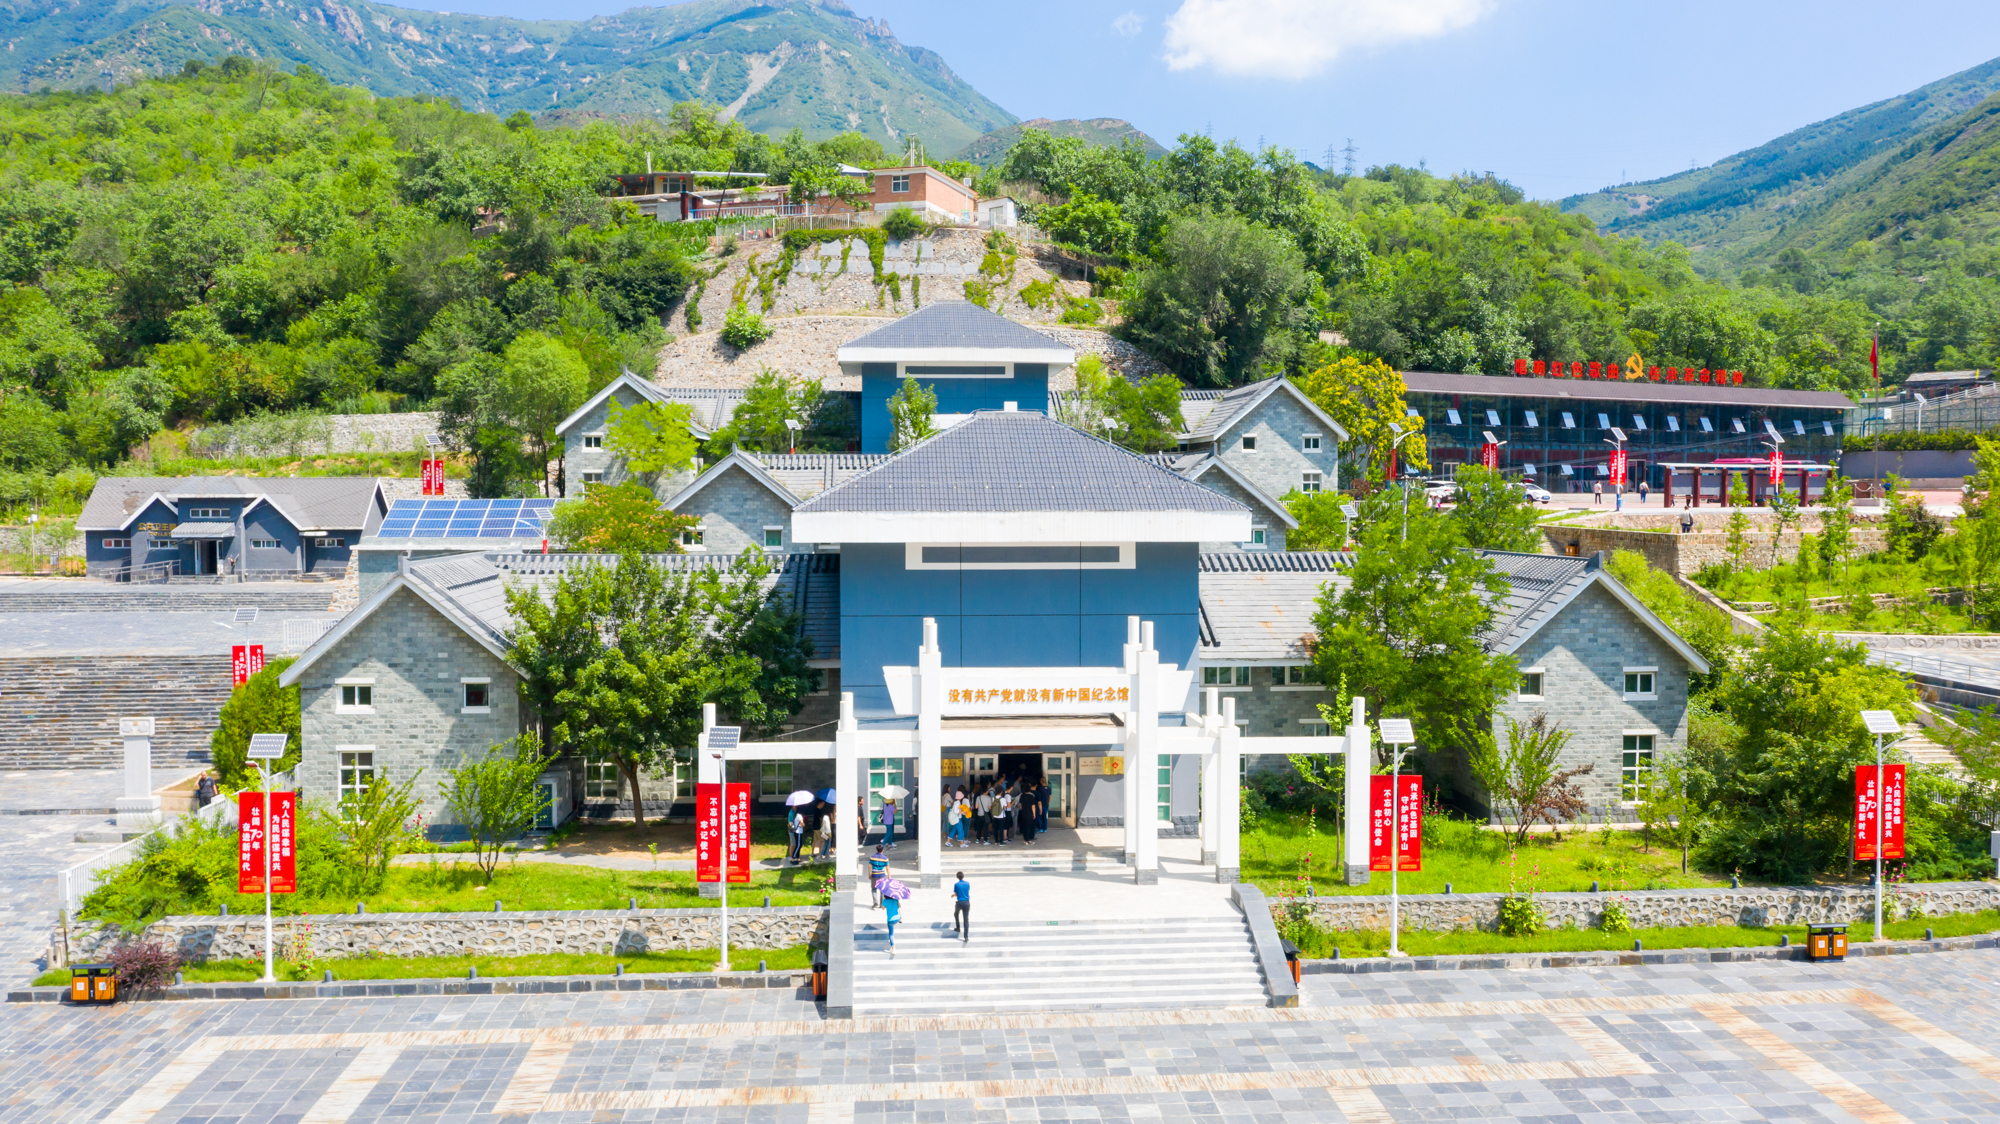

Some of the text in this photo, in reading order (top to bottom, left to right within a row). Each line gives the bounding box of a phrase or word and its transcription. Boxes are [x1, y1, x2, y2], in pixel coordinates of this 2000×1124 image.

[1514, 359, 1743, 385] 唱响红色歌曲 传承革命精神
[948, 686, 1130, 703] 没有共产党就没有新中国纪念馆
[709, 797, 718, 837] 不忘初心
[738, 791, 747, 849] 传承红色基因
[1383, 789, 1392, 827] 不忘初心
[1400, 795, 1409, 851] 守护绿水青山
[1409, 782, 1419, 838] 传承红色基因
[1893, 771, 1902, 825] 为人民谋幸福
[242, 822, 251, 871] 奋进新时代
[272, 814, 281, 871] 为民族谋复兴
[281, 800, 291, 857] 为人民谋幸福
[700, 820, 709, 861] 牢记使命
[729, 804, 738, 862] 守护绿水青山
[1374, 808, 1383, 847] 牢记使命
